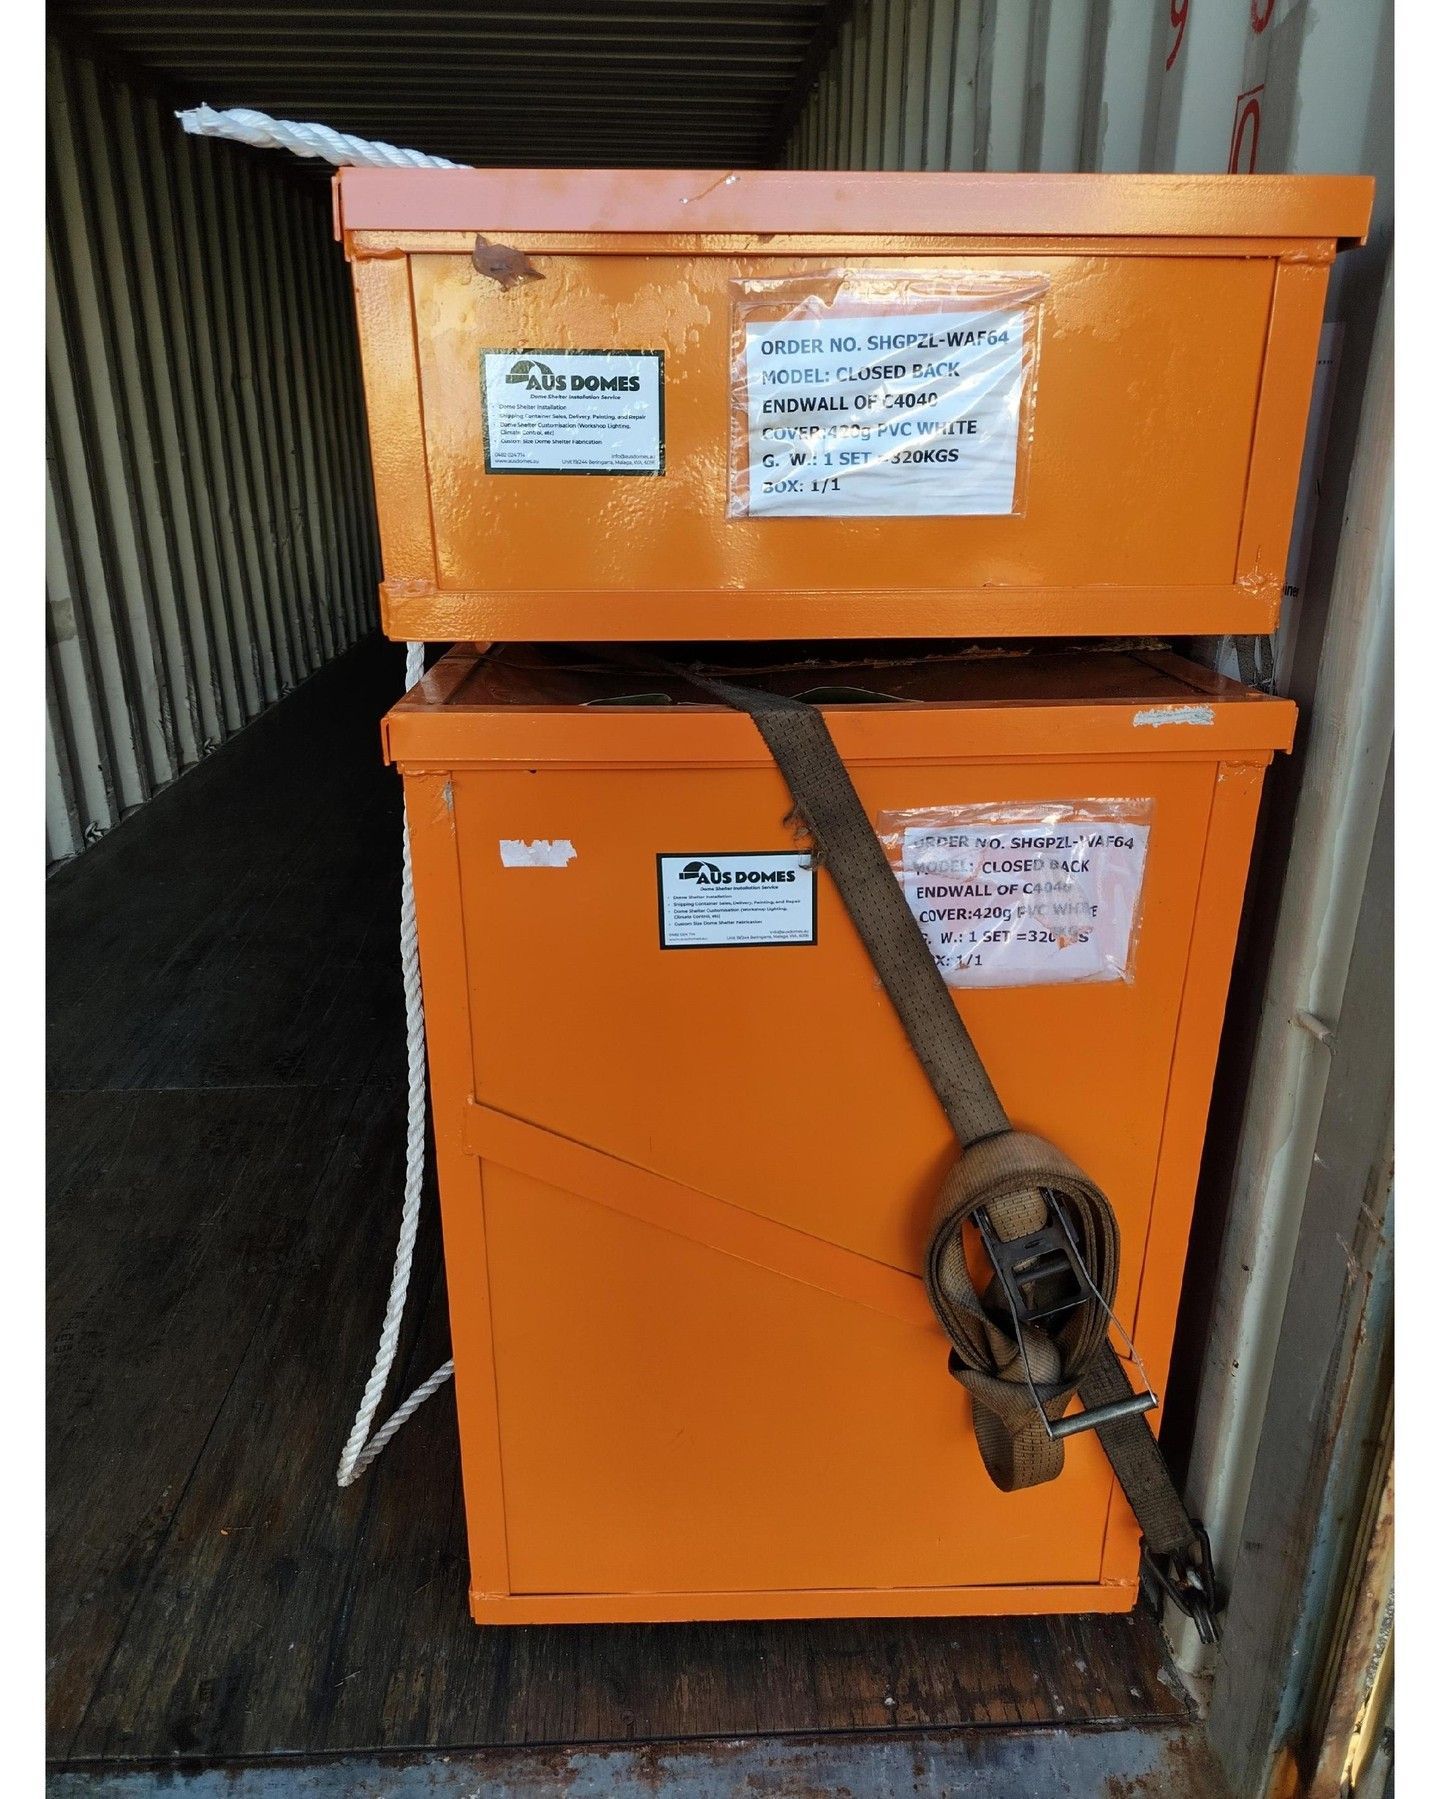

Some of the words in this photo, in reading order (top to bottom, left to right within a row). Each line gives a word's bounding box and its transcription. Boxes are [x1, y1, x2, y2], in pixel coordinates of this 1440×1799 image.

[761, 338, 824, 355] ORDER
[829, 336, 861, 353] NO.
[867, 329, 1010, 351] SHGPZL-WAF64
[762, 368, 830, 385] MODEL:
[836, 364, 906, 382] CLOSED
[912, 361, 960, 378] BACK
[526, 375, 567, 391] AUS
[571, 375, 640, 391] DOMES
[762, 396, 849, 414] ENDWALL
[854, 394, 878, 410] OF
[883, 392, 938, 409] C4040
[878, 422, 912, 438] PVC
[917, 420, 977, 437] WHITE
[762, 454, 780, 468] G.
[824, 453, 833, 466] 1
[840, 452, 872, 466] SET
[763, 480, 803, 494] BOX:
[811, 477, 840, 494] 1/1
[914, 835, 970, 848] ORDER
[976, 838, 1004, 849] NO.
[1011, 835, 1134, 849] SHGPZL-WAF64
[982, 859, 1044, 873] CLOSED
[1050, 860, 1089, 873] BACK
[697, 872, 732, 884] AUS
[735, 871, 795, 883] DOMES
[917, 885, 992, 898] ENDWALL
[997, 884, 1018, 896] OF
[920, 907, 1011, 922] COVER:420g
[940, 932, 963, 944] W.:
[983, 931, 1010, 943] SET
